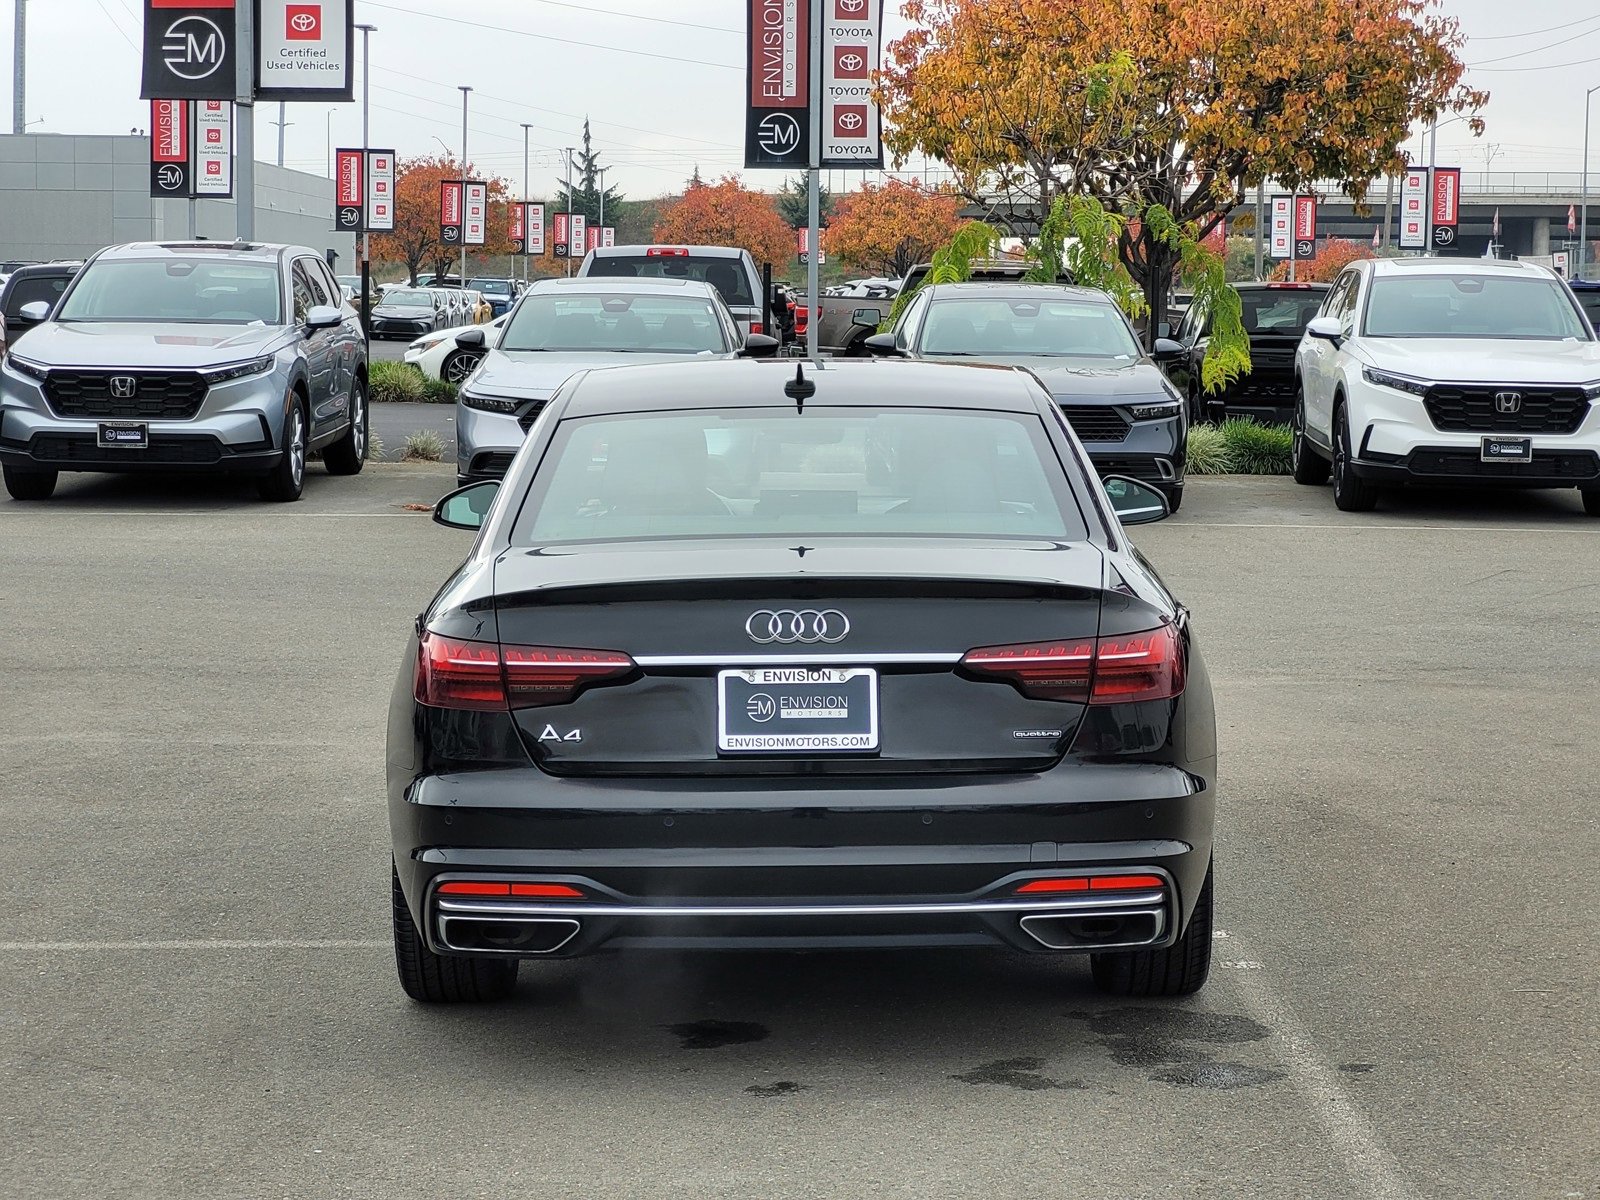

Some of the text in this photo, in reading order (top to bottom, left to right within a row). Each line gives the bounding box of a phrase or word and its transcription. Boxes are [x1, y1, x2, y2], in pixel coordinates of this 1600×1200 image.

[829, 28, 873, 37] TOYOTA
[786, 1, 794, 88] MOTORS
[280, 48, 327, 57] Certified
[266, 61, 340, 70] Used Vehicles
[829, 87, 871, 96] TOYOTA
[828, 145, 872, 154] TOYOTA
[342, 156, 351, 202] ENVISION
[445, 186, 453, 222] ENVISION
[1437, 175, 1447, 221] ENVISION
[763, 670, 832, 682] ENVISION
[780, 696, 848, 708] ENVISION
[538, 724, 582, 743] A4
[727, 737, 870, 748] ENVISIONMOTORS.COM
